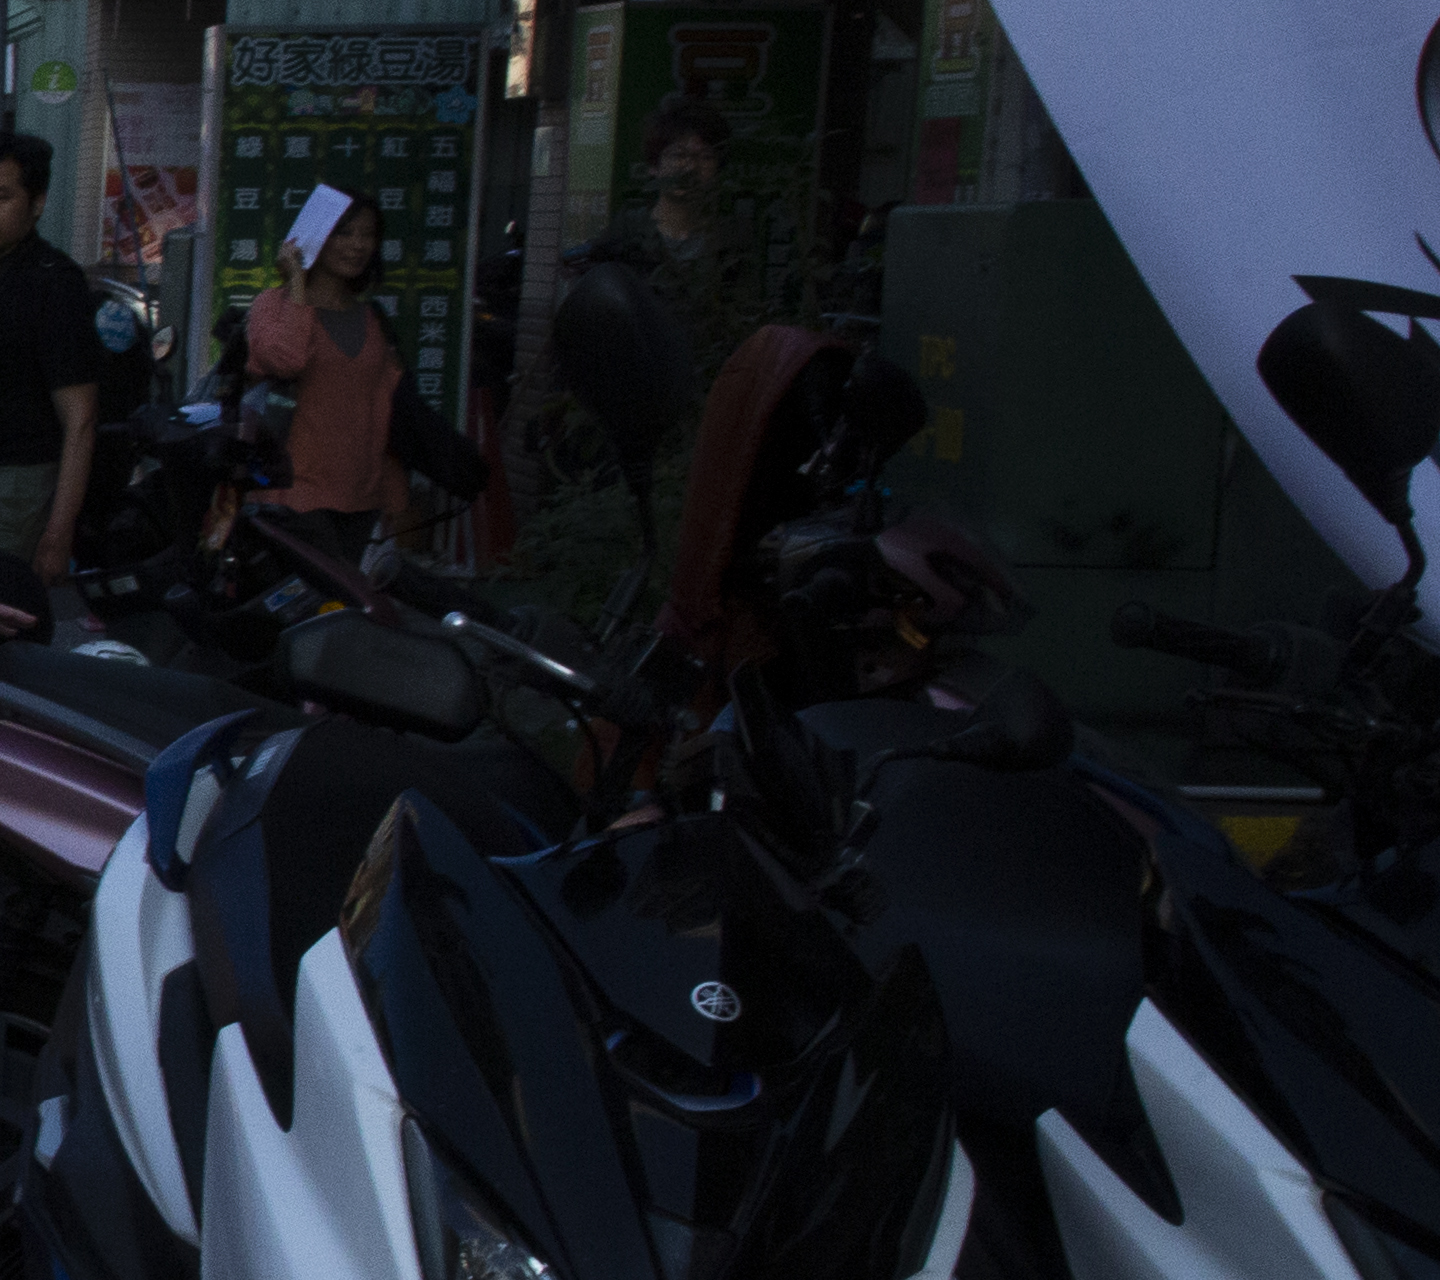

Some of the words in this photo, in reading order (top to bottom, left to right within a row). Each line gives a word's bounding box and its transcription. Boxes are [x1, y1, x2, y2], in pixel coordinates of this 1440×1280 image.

[232, 35, 470, 87] 好家綠豆湯
